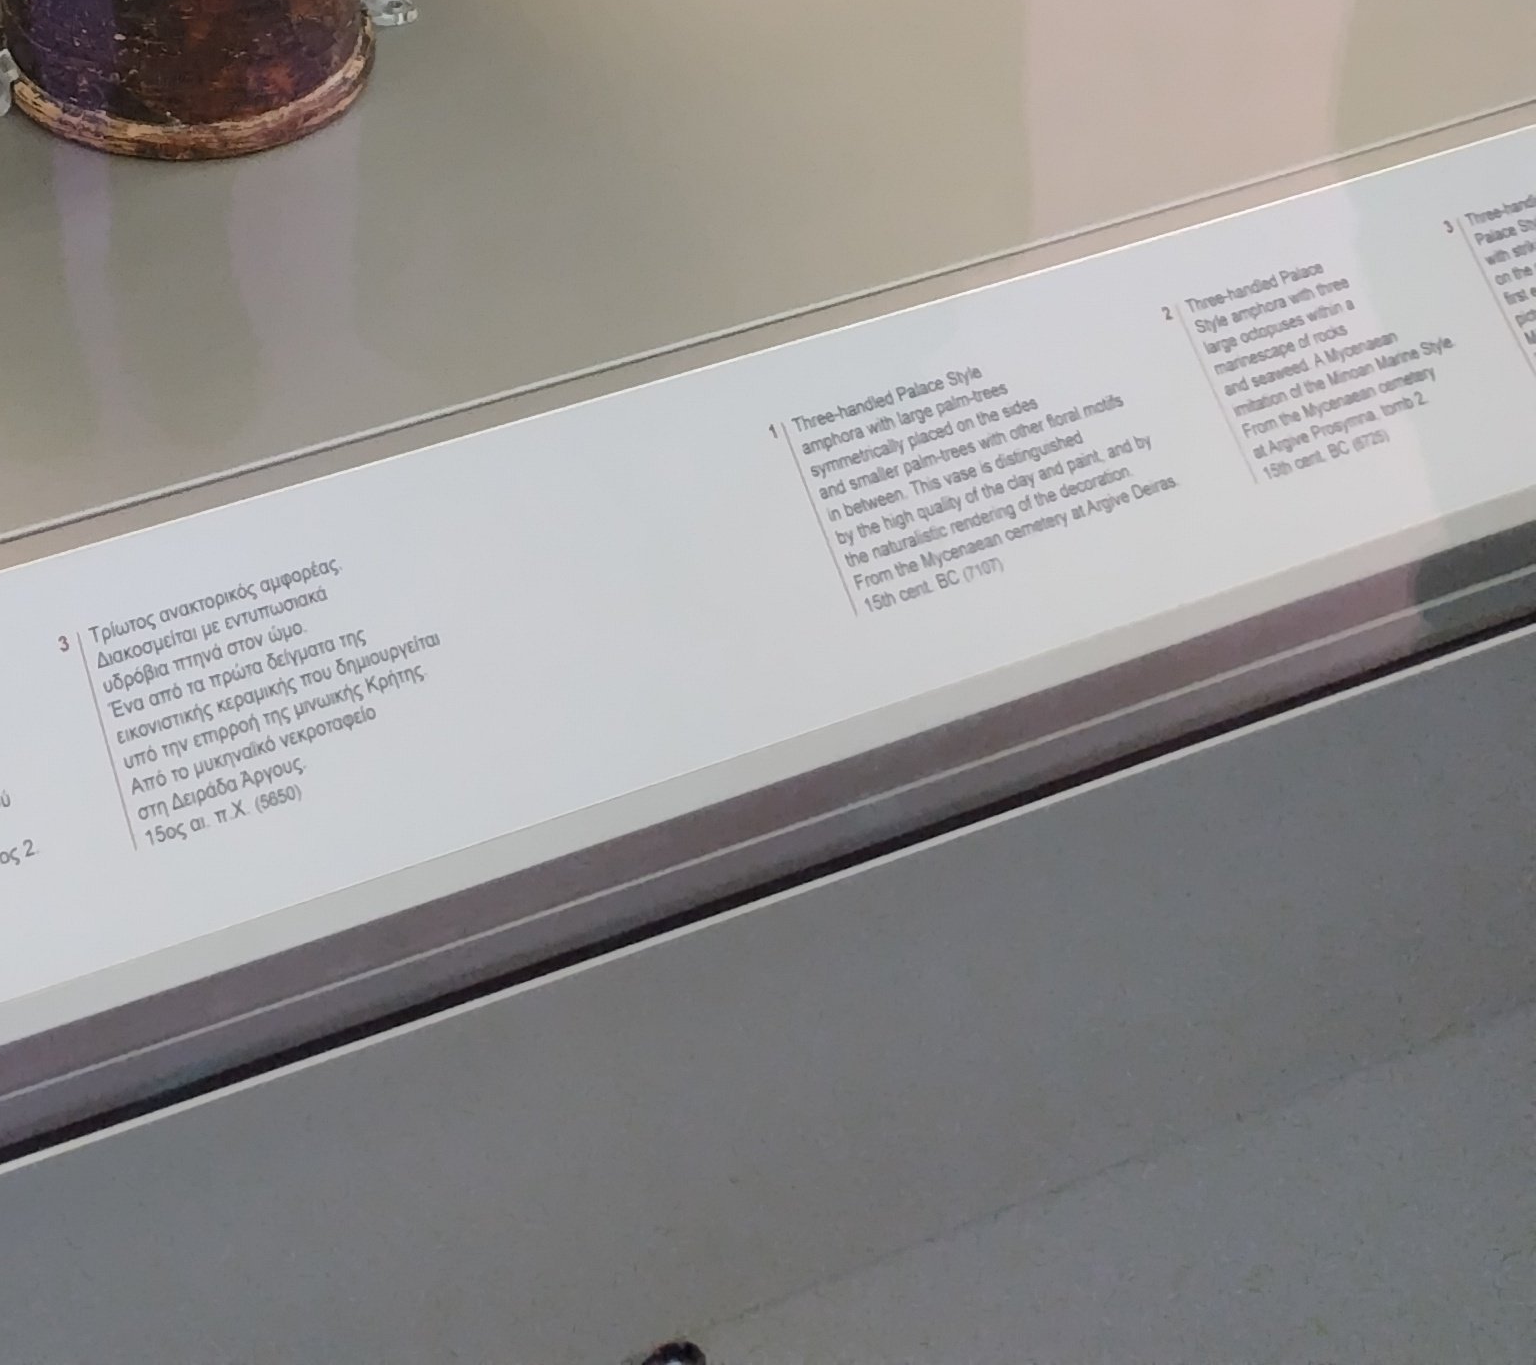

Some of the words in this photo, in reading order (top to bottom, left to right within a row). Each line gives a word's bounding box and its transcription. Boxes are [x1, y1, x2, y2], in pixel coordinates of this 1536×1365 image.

[58, 635, 69, 653] 3
[88, 613, 157, 645] Τρίωτος
[159, 582, 258, 623] ανακτορικός
[97, 627, 198, 669] Διακοσμείται
[201, 621, 221, 641] με
[224, 585, 328, 630] εντυπωσιακά
[102, 663, 170, 694] υδρόβια
[172, 643, 224, 671] πτηνά
[227, 634, 263, 656] στον
[107, 697, 145, 718] Ένα
[148, 682, 183, 707] από
[186, 679, 206, 695] τα
[208, 661, 264, 689] πρώτα
[266, 639, 336, 670] δείγματα
[338, 629, 367, 649] της
[116, 703, 214, 745] εικονιστικής
[216, 677, 298, 713] κεραμικής
[299, 666, 332, 687] που
[335, 633, 441, 676] δημιουργείται
[123, 745, 158, 769] υπό
[161, 738, 188, 758] την
[193, 713, 261, 748] επιρροή
[262, 706, 291, 726] της
[293, 683, 364, 720] μινωικής
[132, 769, 167, 796] Από
[170, 766, 189, 782] το
[193, 735, 276, 779] μυκηναϊκό
[279, 705, 376, 748] νεκροταφείο
[137, 800, 170, 821] στη
[172, 777, 239, 811] Δειράδα
[145, 822, 188, 846] 15ος
